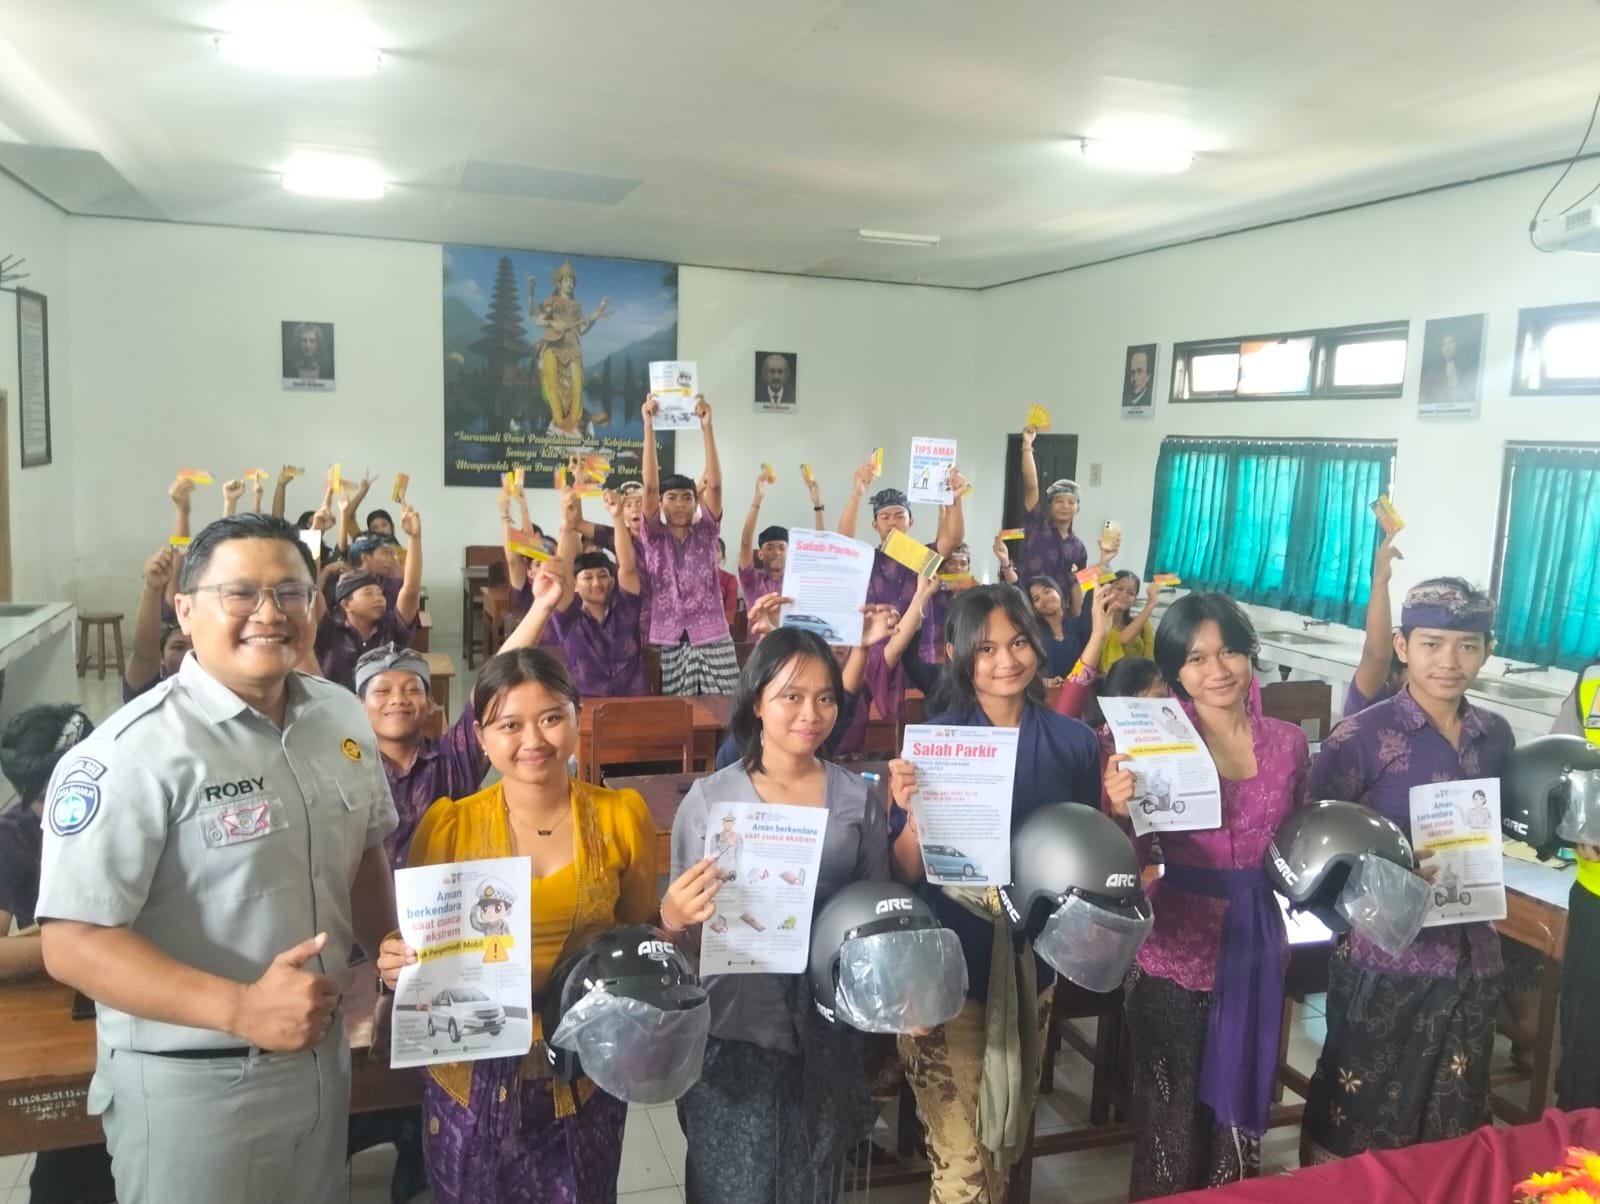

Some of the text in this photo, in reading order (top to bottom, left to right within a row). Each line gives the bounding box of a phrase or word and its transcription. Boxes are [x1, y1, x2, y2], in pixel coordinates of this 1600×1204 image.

[915, 445, 955, 457] TIPS AMAN
[795, 541, 860, 558] Salah Parkir
[912, 742, 998, 758] Salah Parkir
[205, 776, 265, 801] ROBY
[1433, 801, 1453, 810] Aman
[1416, 811, 1453, 822] berkendara
[752, 823, 818, 835] Aman berkendara
[1502, 817, 1529, 836] ARC
[744, 832, 817, 844] saat cuaca ekstrem
[1105, 873, 1137, 888] ARC
[1273, 857, 1300, 887] ARC
[436, 889, 462, 902] Aman
[406, 902, 462, 919] berkendara
[875, 898, 913, 915] ARC
[1000, 888, 1021, 923] ARC
[411, 915, 461, 932] saat cuaca
[425, 927, 461, 943] ekstrem
[428, 943, 461, 957] Pengemudi
[463, 939, 484, 950] Mobil
[637, 940, 676, 957] ARC
